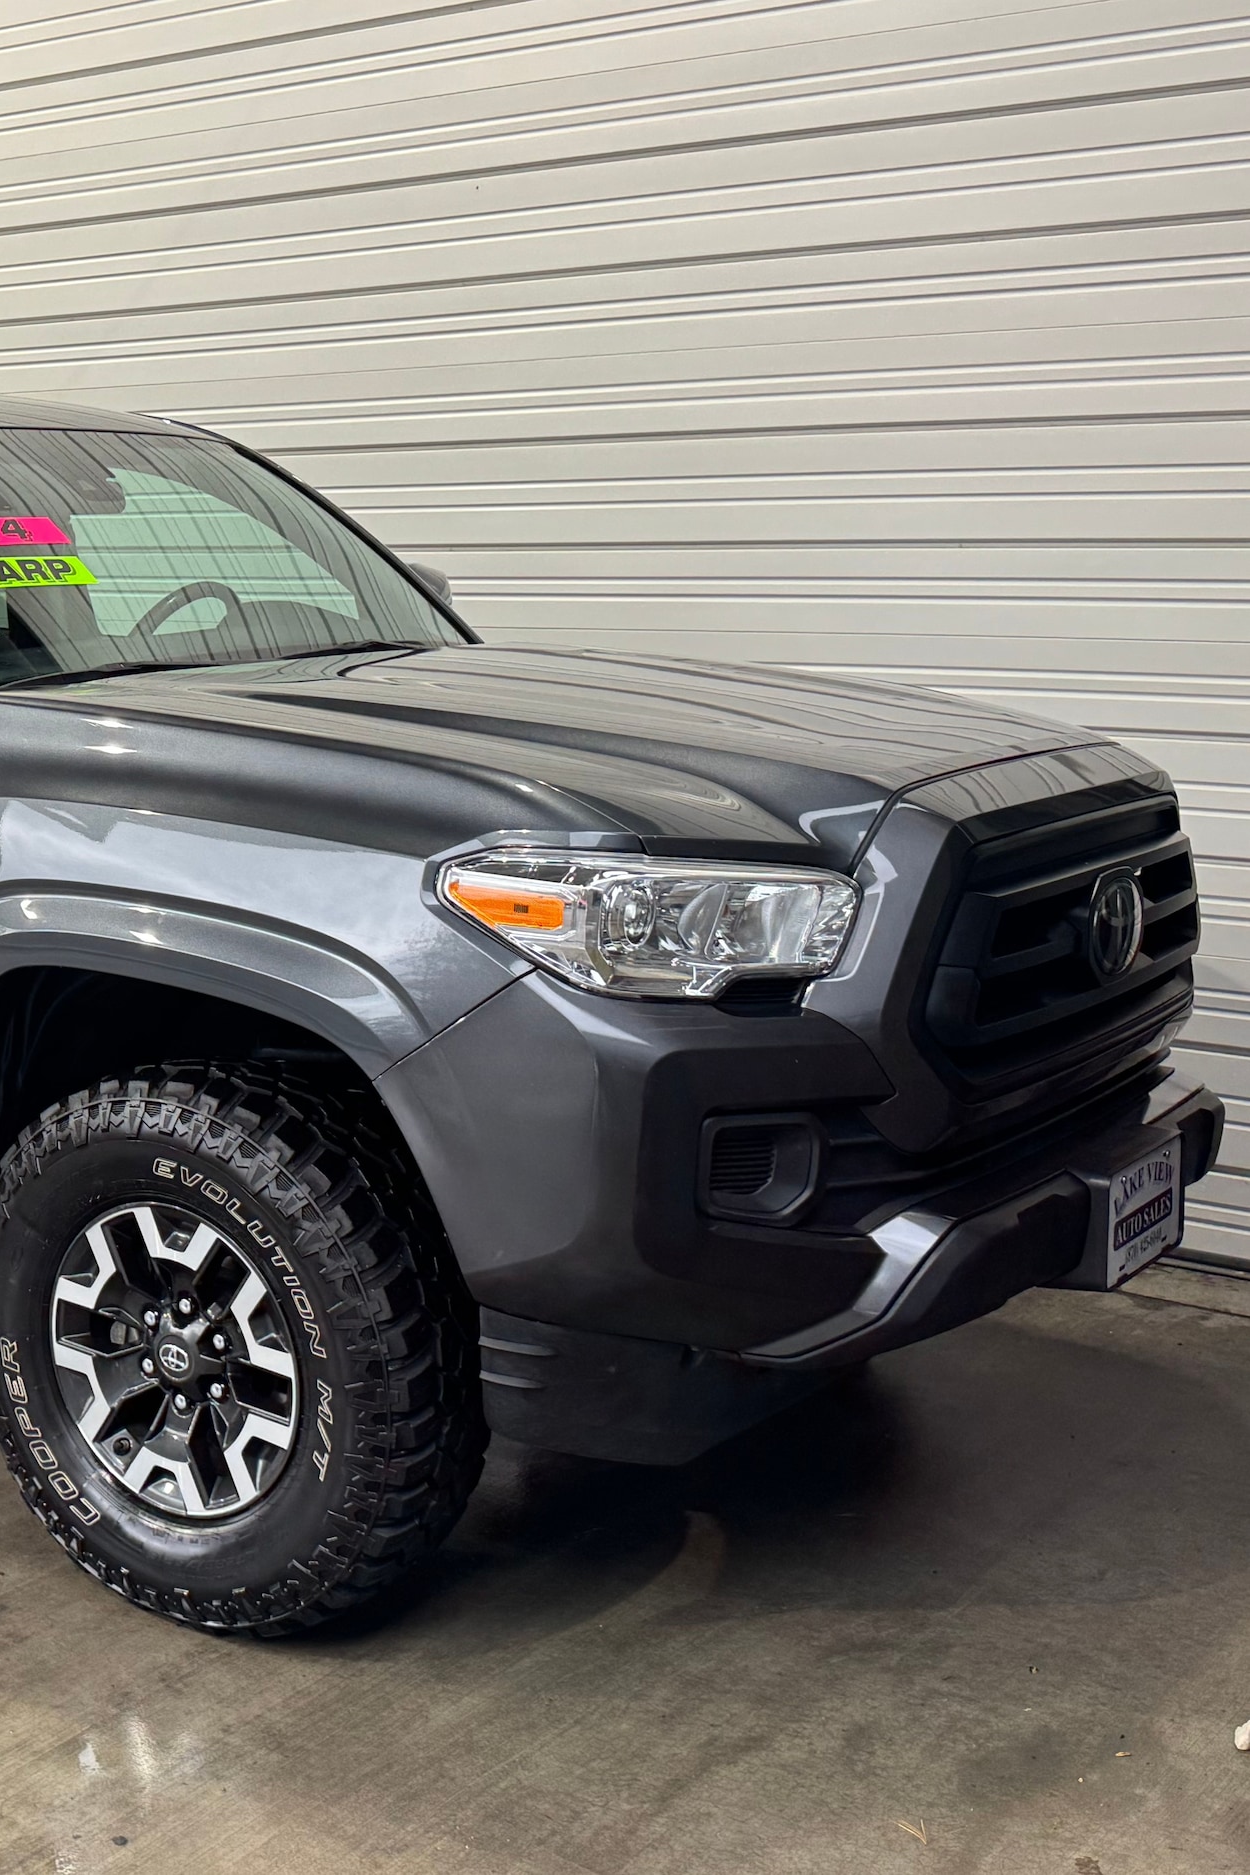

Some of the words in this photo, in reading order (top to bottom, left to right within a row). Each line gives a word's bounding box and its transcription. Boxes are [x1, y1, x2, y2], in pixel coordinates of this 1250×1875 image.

[1147, 1160, 1175, 1187] VIEW
[1115, 1217, 1143, 1245] AUTO
[1143, 1192, 1172, 1228] SALES
[153, 1156, 327, 1359] EVOLUTION
[303, 1378, 334, 1483] M/T
